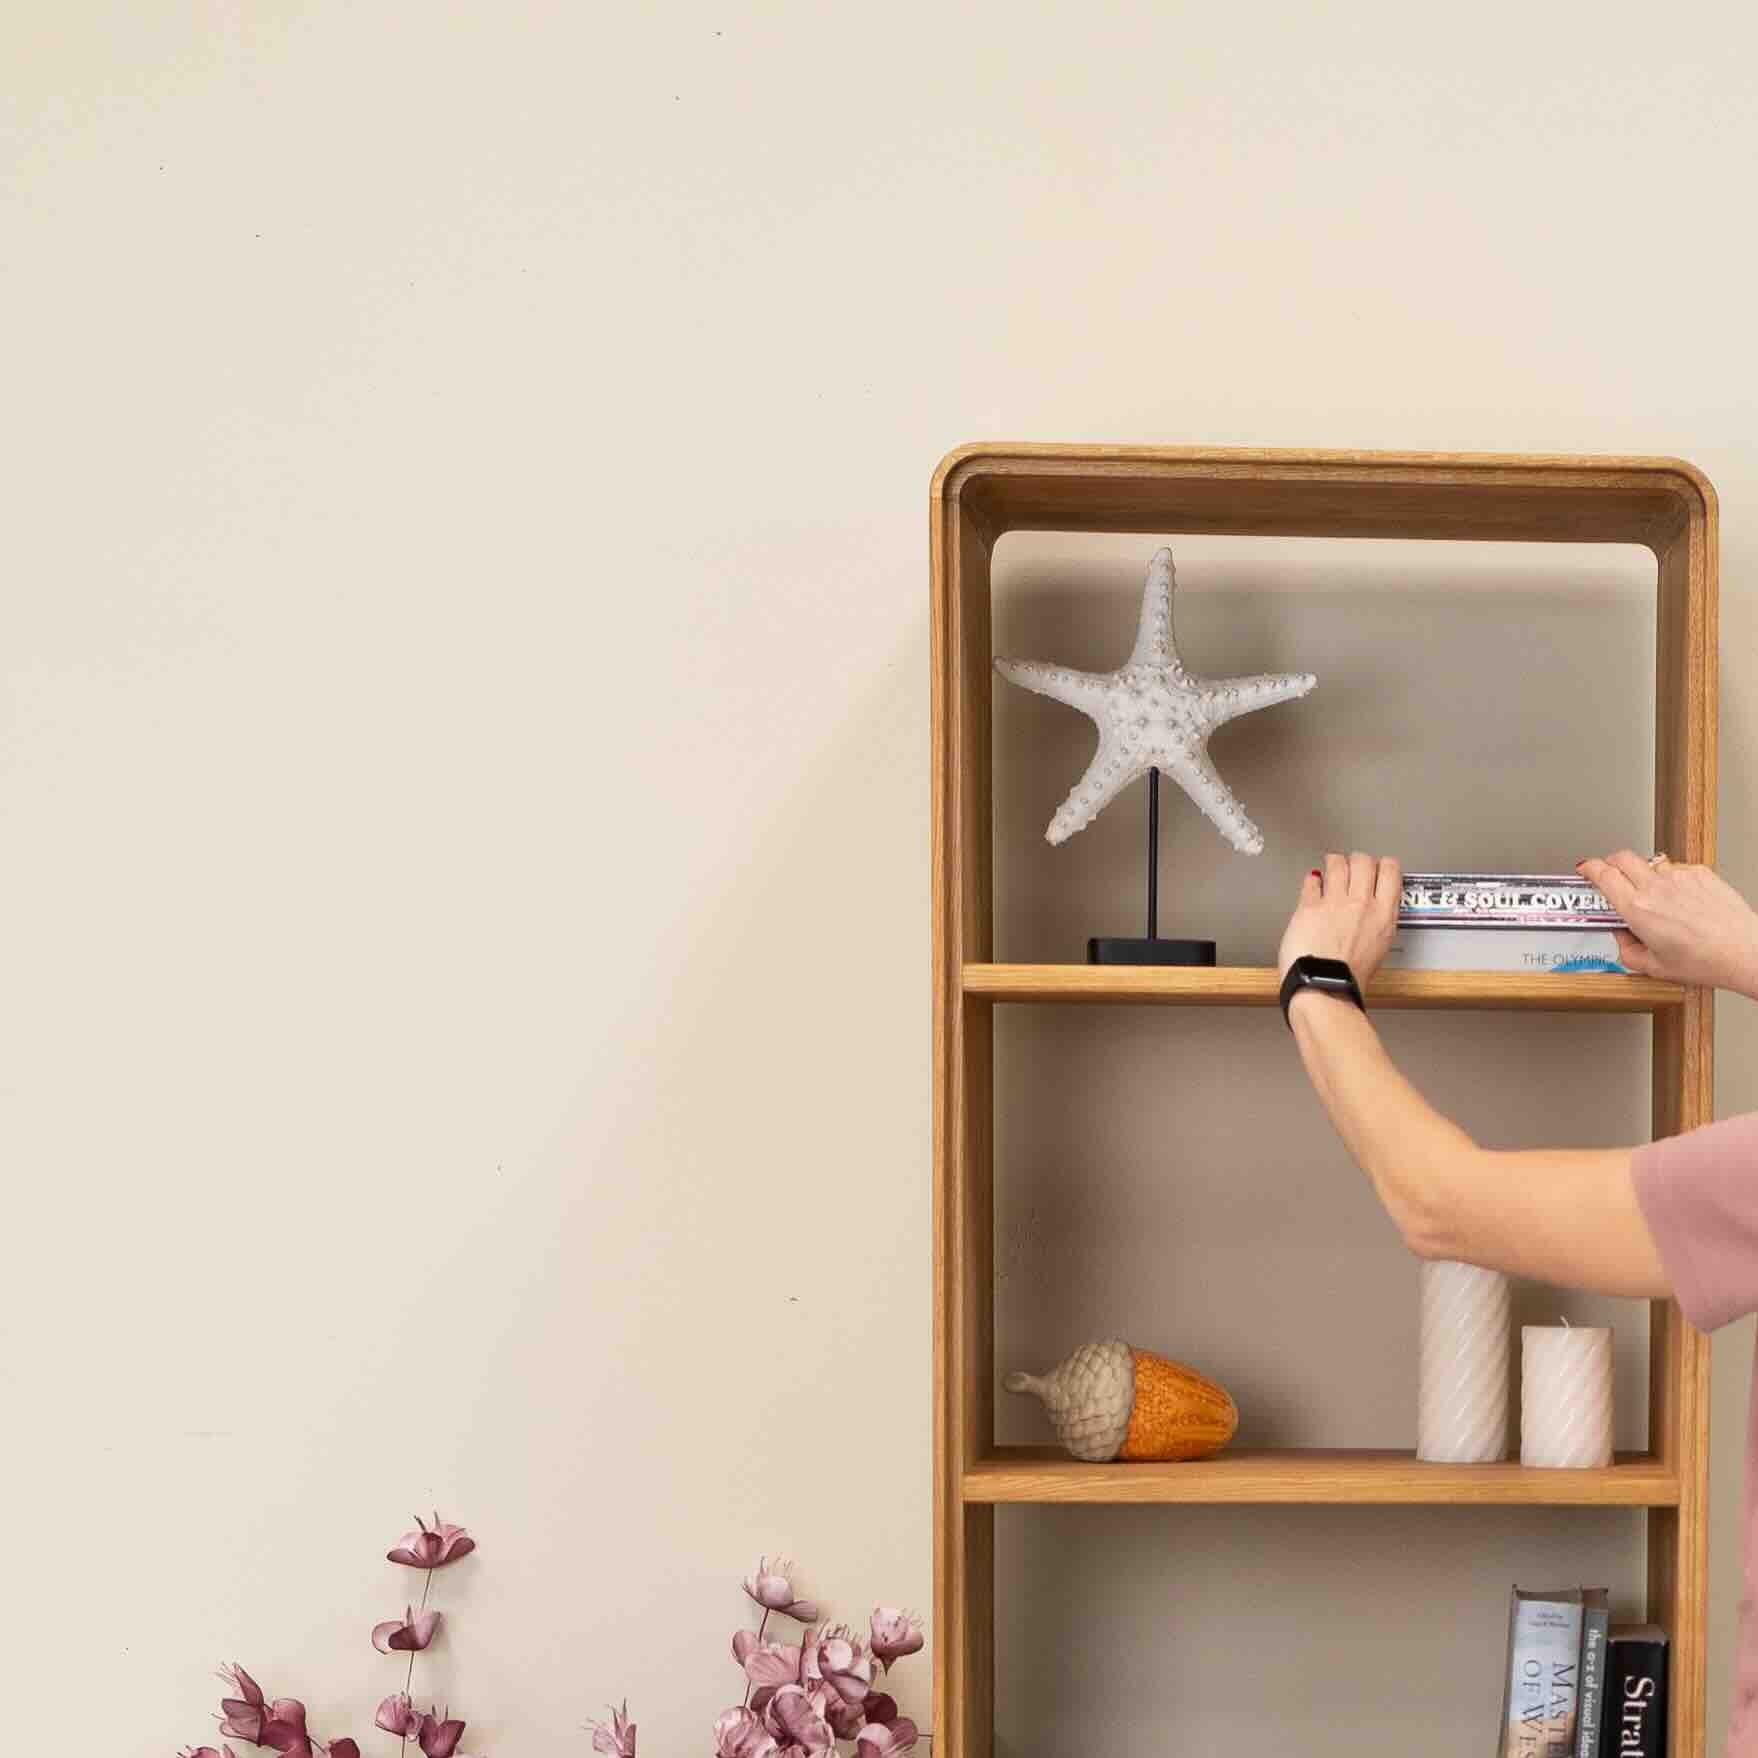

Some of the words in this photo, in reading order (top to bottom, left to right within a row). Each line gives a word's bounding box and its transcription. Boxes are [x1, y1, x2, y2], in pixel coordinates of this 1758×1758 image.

[1401, 890, 1435, 907] NK
[1440, 889, 1458, 907] &
[1464, 889, 1527, 909] SOUL
[1530, 890, 1613, 911] COVER
[1522, 953, 1549, 966] THE
[1587, 1628, 1601, 1649] the
[1523, 1659, 1542, 1695] OF
[1583, 1674, 1599, 1689] of
[1582, 1691, 1597, 1729] visual
